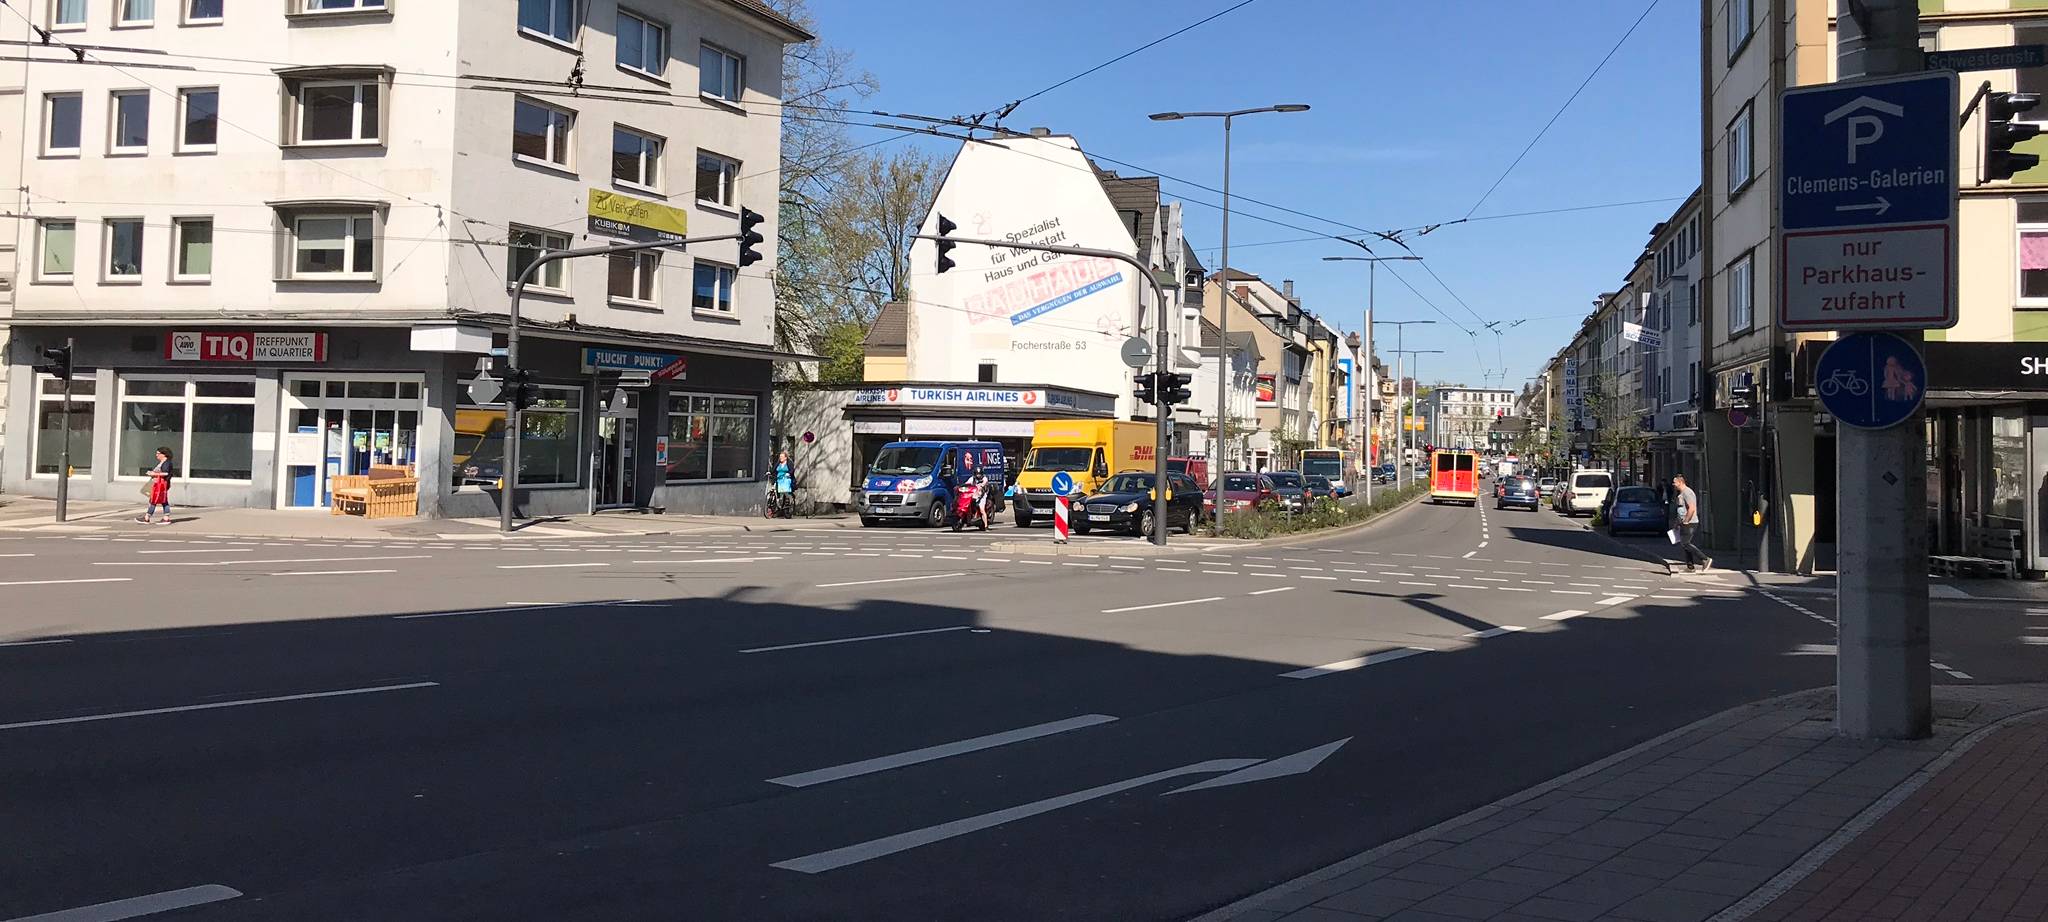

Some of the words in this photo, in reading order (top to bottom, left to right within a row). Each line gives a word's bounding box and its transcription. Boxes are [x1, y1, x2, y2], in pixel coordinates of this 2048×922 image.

[1928, 49, 2039, 69] Schwesternstr.
[1848, 115, 1884, 164] P
[1787, 167, 1945, 195] Clemens-Galerien
[610, 198, 649, 219] Verkaufen
[594, 219, 630, 232] KUBIKOM
[1006, 216, 1061, 244] Spezialist
[1842, 240, 1882, 256] nur
[991, 251, 1007, 265] für
[985, 266, 1014, 282] Haus
[1017, 255, 1038, 272] und
[1802, 264, 1926, 285] Parkhaus-
[1821, 291, 1906, 311] zufahrt
[206, 336, 249, 360] TIQ
[255, 336, 309, 347] TREFFPUNKT
[1011, 340, 1071, 351] Focherstraße
[1075, 340, 1087, 350] 53
[255, 347, 267, 357] IM
[269, 347, 313, 358] QUARTIER
[596, 352, 627, 365] FLUCHT
[634, 355, 664, 368] PUNKT!
[2020, 357, 2048, 375] SH
[911, 390, 962, 401] TURKISH
[966, 391, 1019, 402] AIRLINES
